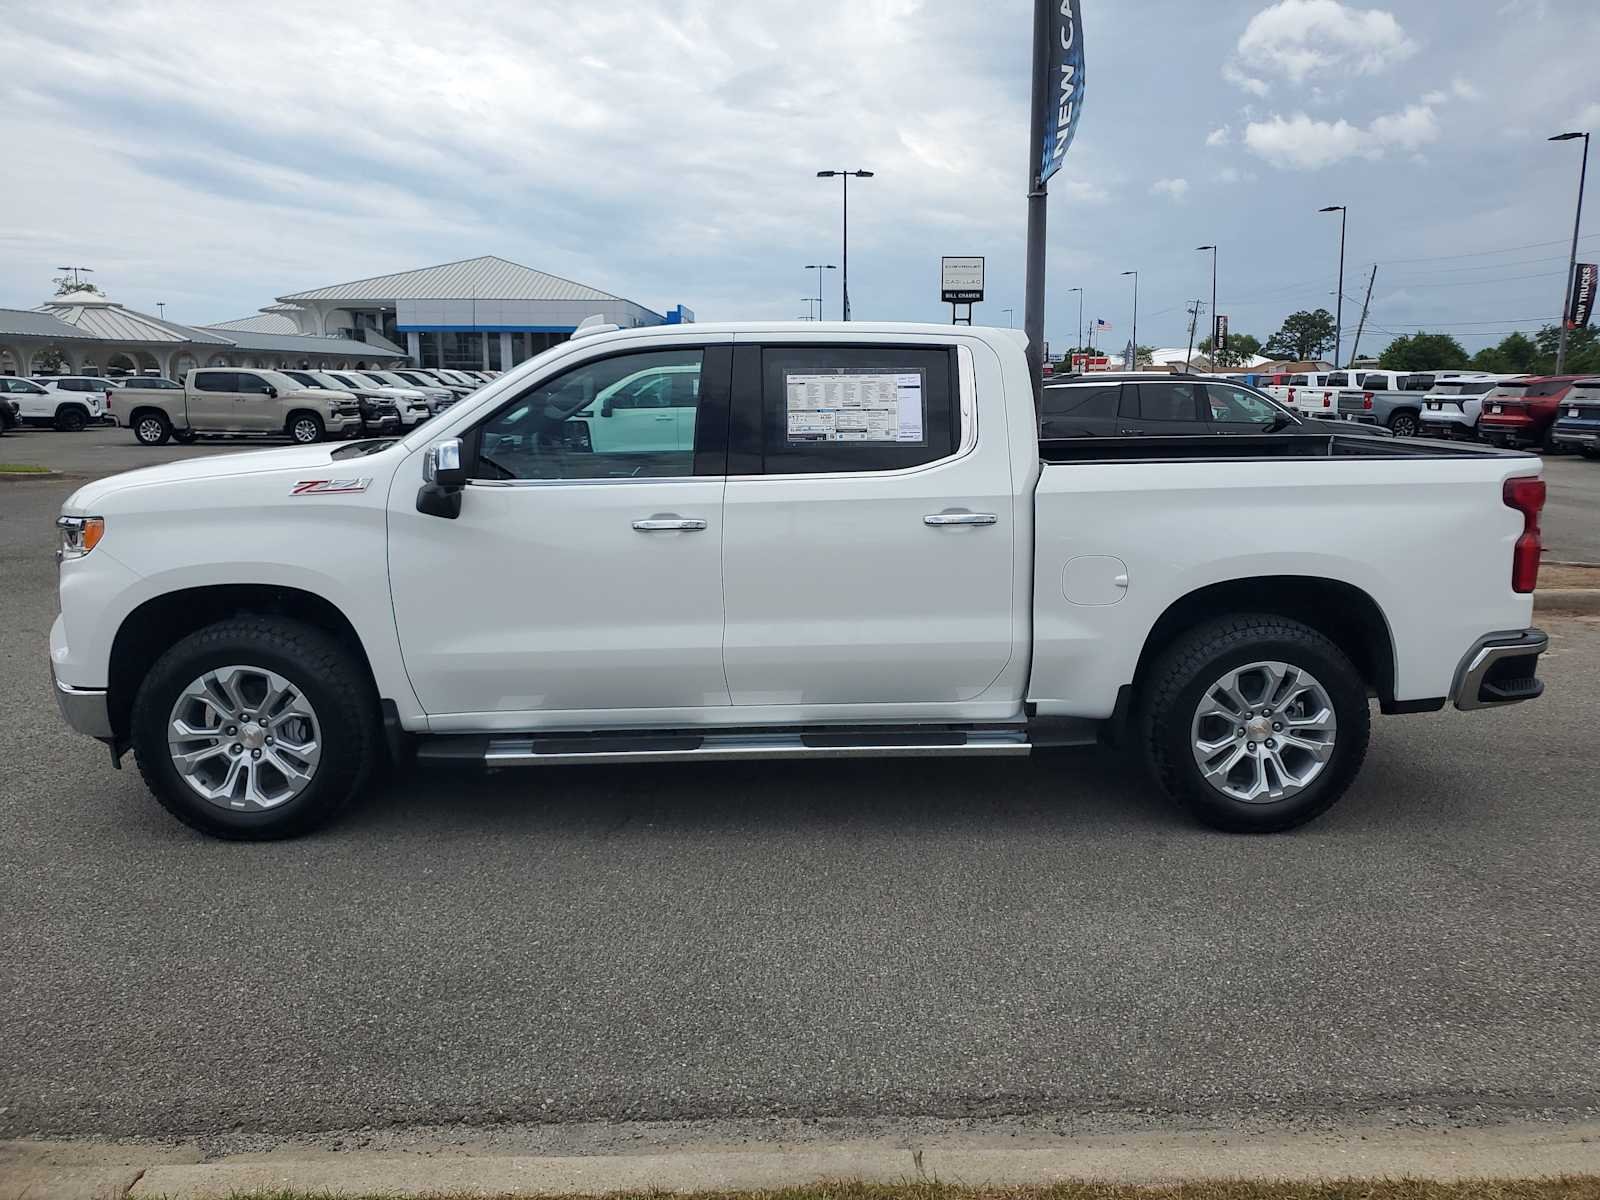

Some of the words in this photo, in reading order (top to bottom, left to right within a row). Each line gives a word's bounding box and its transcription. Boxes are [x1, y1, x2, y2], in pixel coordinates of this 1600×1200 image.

[1053, 64, 1075, 159] NEW
[1579, 267, 1591, 303] TRUCKS
[1575, 304, 1587, 325] NEW
[288, 479, 374, 497] Z71
